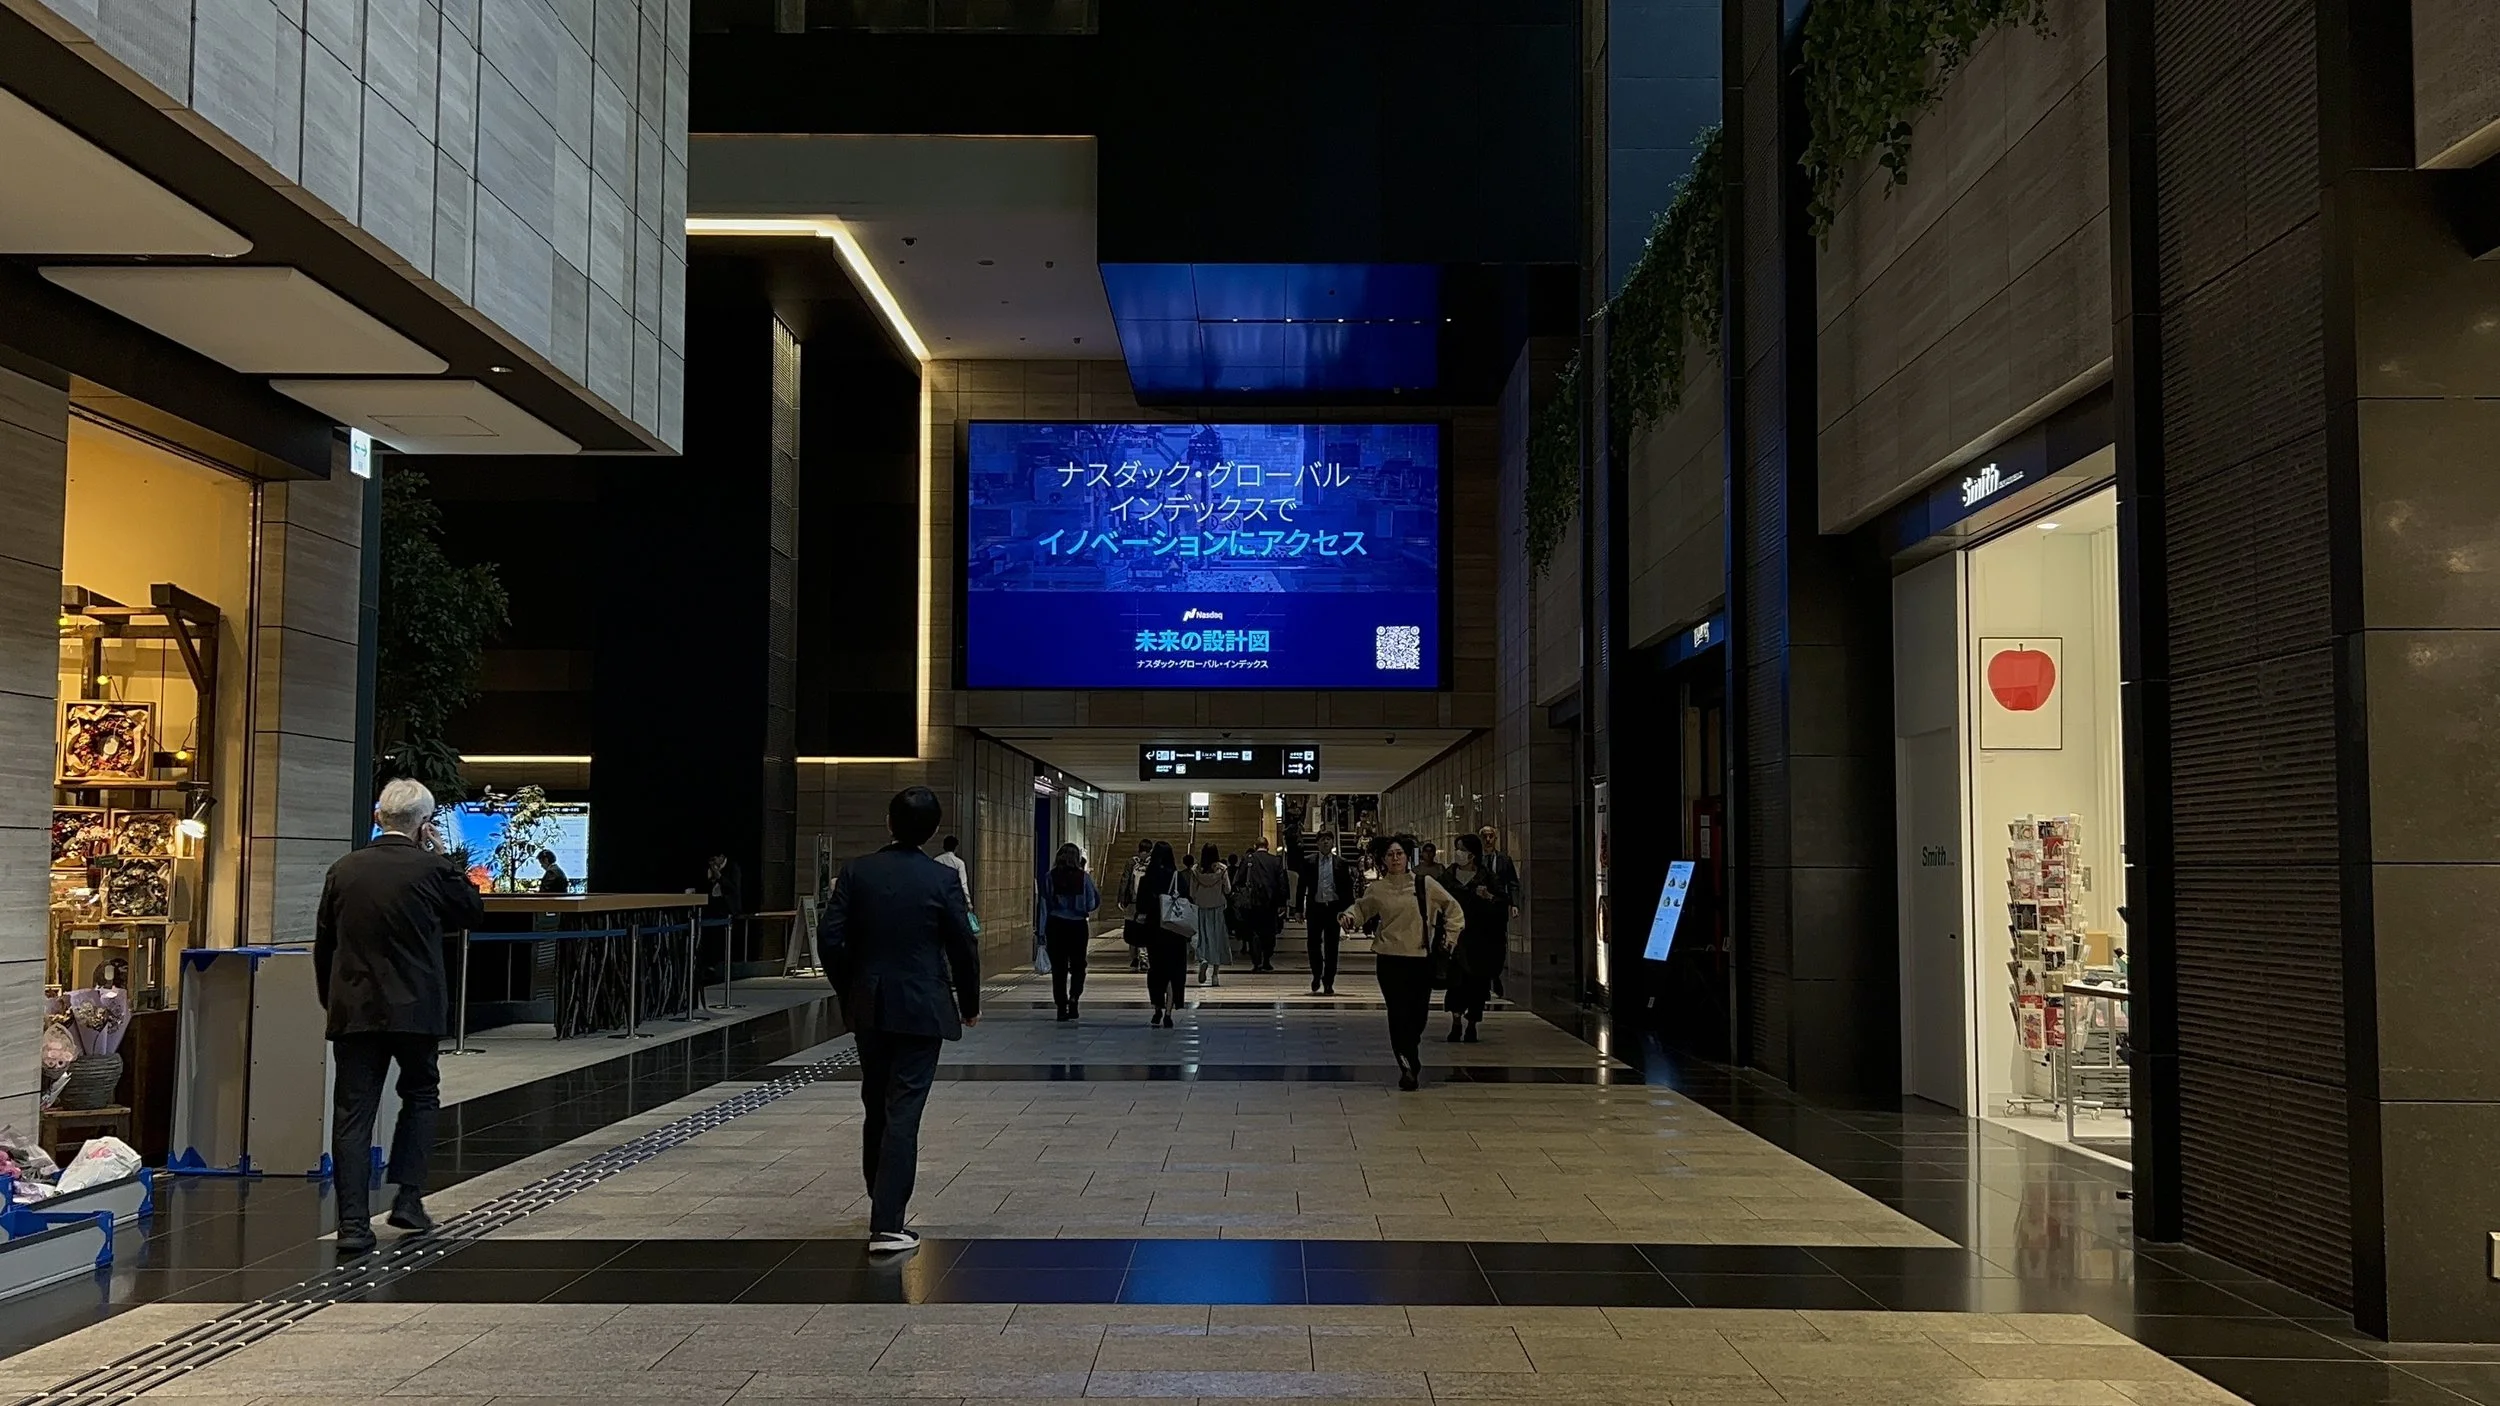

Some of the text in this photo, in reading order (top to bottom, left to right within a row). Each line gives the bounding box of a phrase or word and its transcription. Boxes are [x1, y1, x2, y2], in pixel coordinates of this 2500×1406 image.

[1057, 461, 1350, 488] ナスダック・グローバル
[1962, 463, 2000, 507] Smith
[1109, 495, 1297, 523] インデックスで
[1038, 529, 1368, 557] イノベーションにアクセス
[1196, 610, 1223, 620] Nasdaq
[1135, 629, 1270, 652] 未来の設計図
[1136, 659, 1269, 669] ナスダック・グローバル・インデックス
[1922, 845, 1947, 867] Smith
